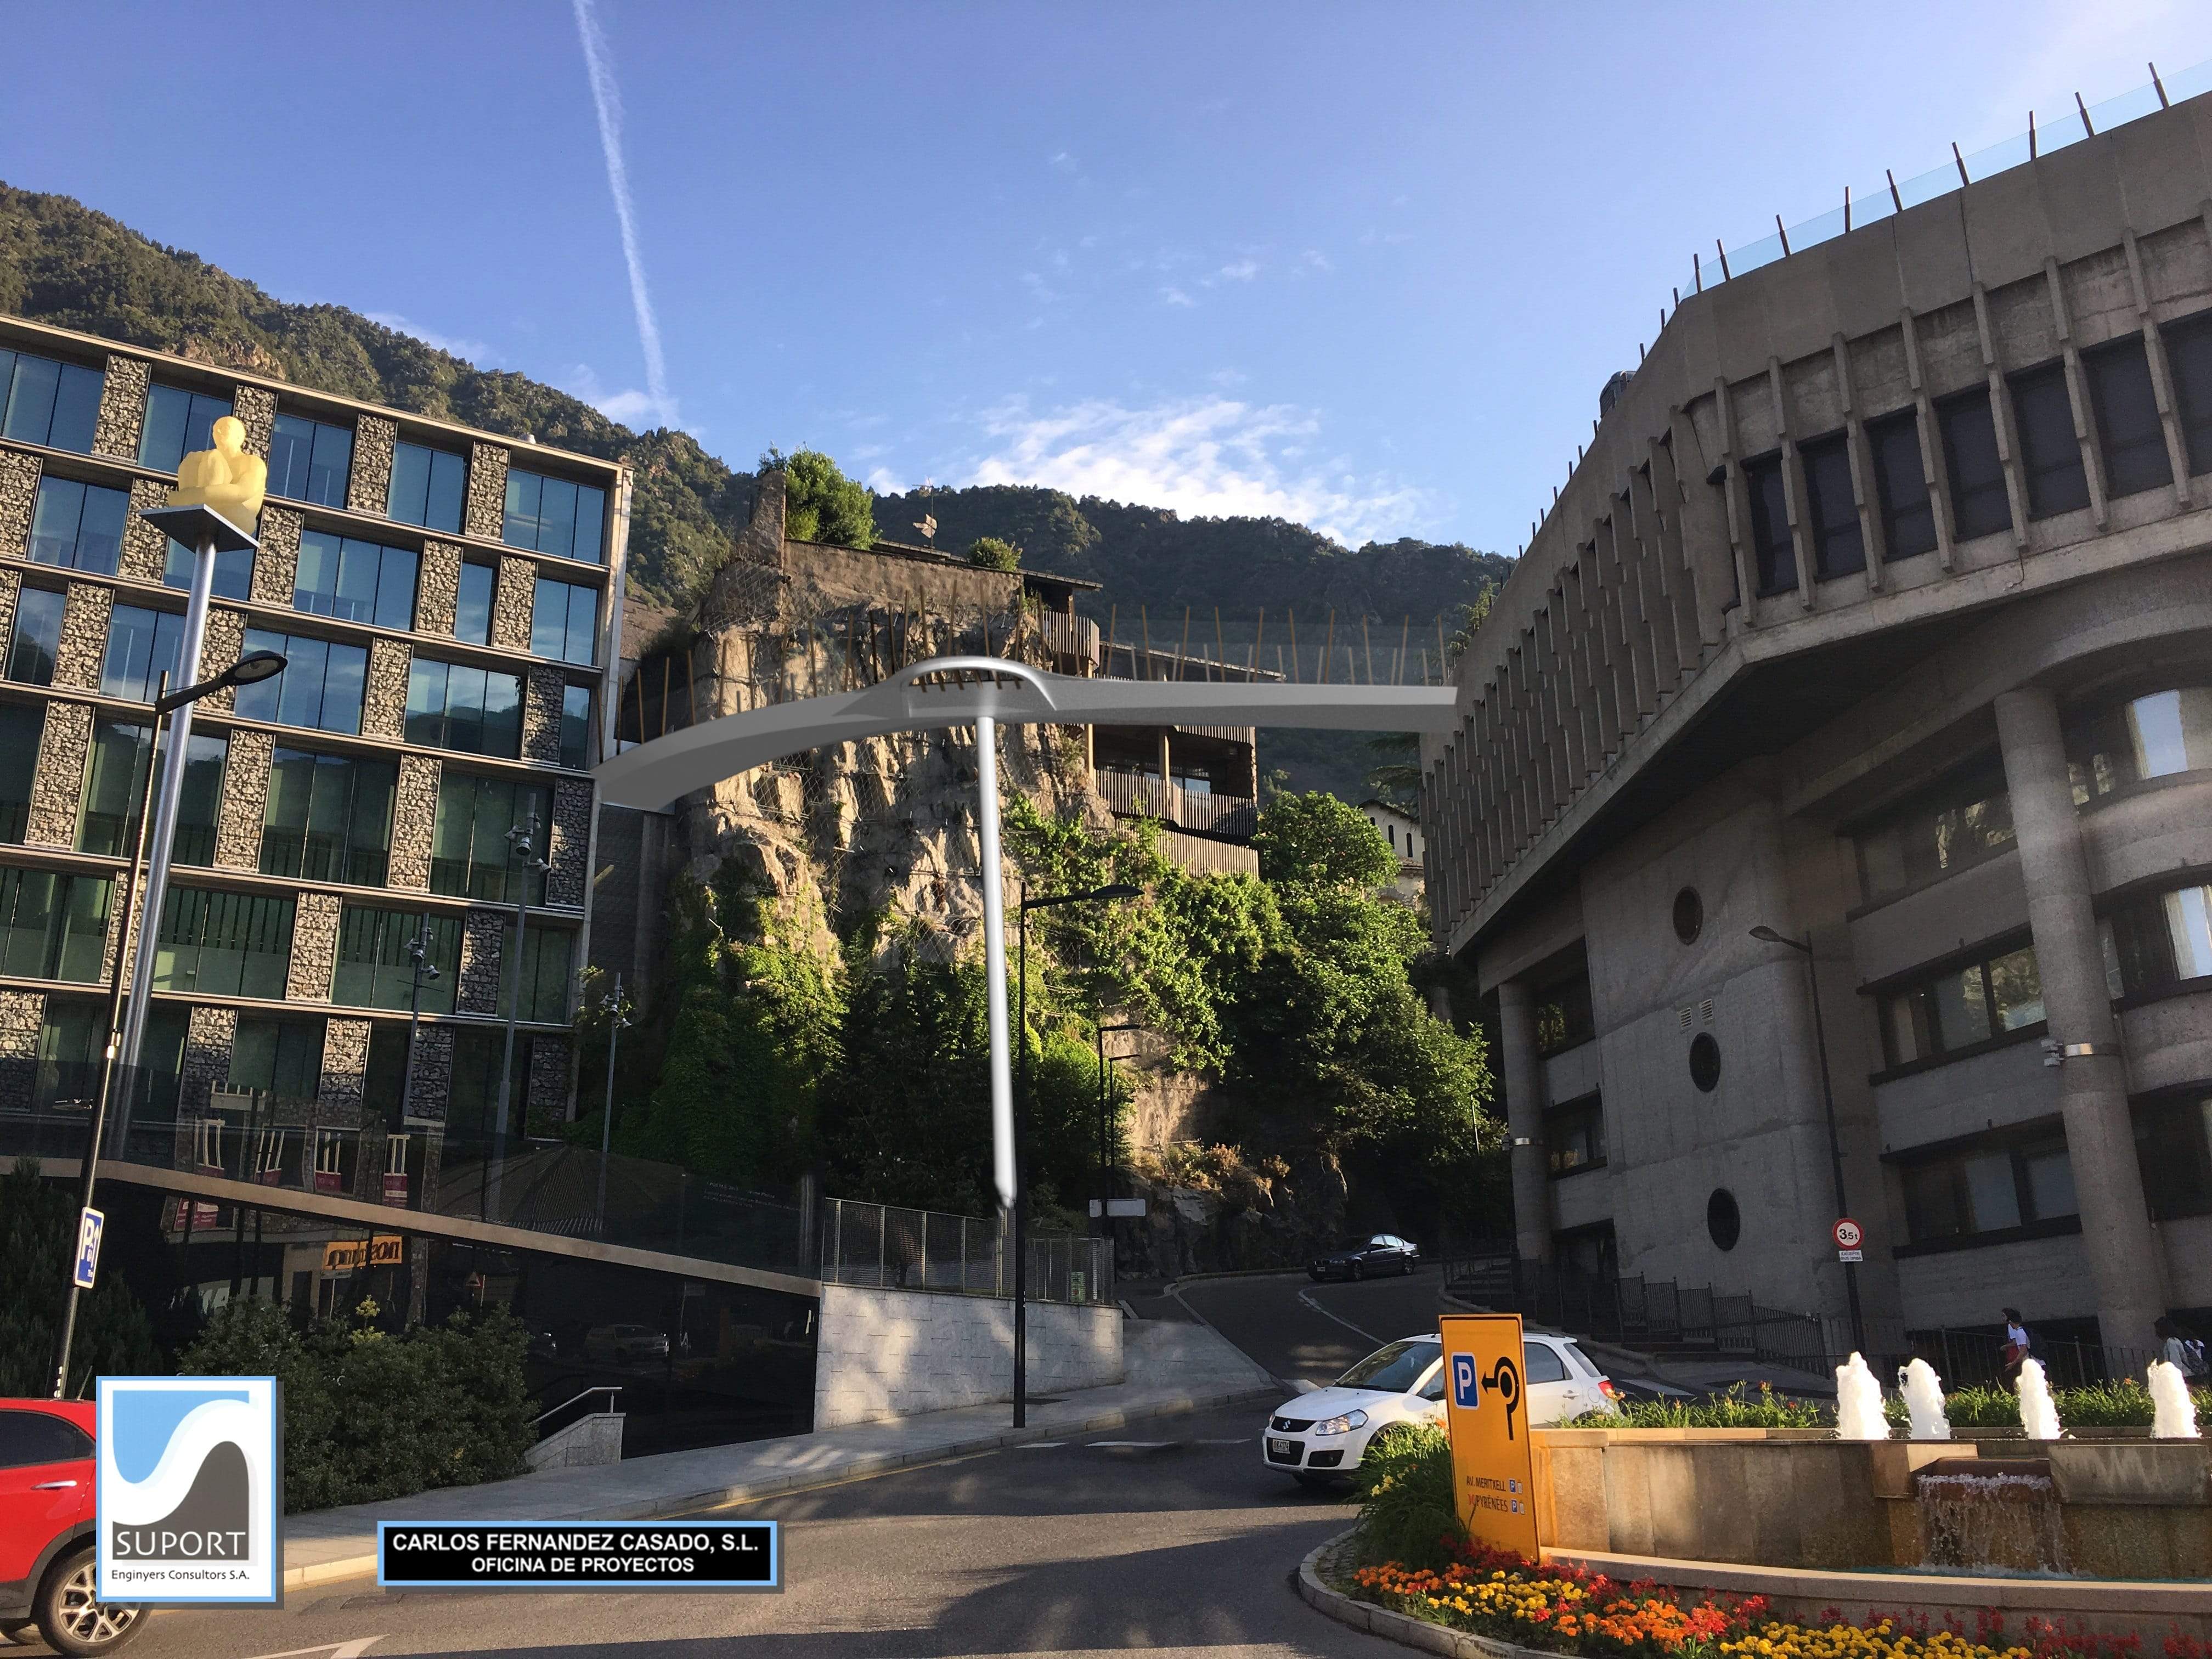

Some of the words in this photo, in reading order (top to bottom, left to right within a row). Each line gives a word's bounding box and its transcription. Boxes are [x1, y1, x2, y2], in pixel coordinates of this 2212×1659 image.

[81, 1218, 94, 1260] P
[1458, 1362, 1472, 1399] P
[1466, 1475, 1475, 1486] AV.
[1476, 1477, 1506, 1492] MERITXELL
